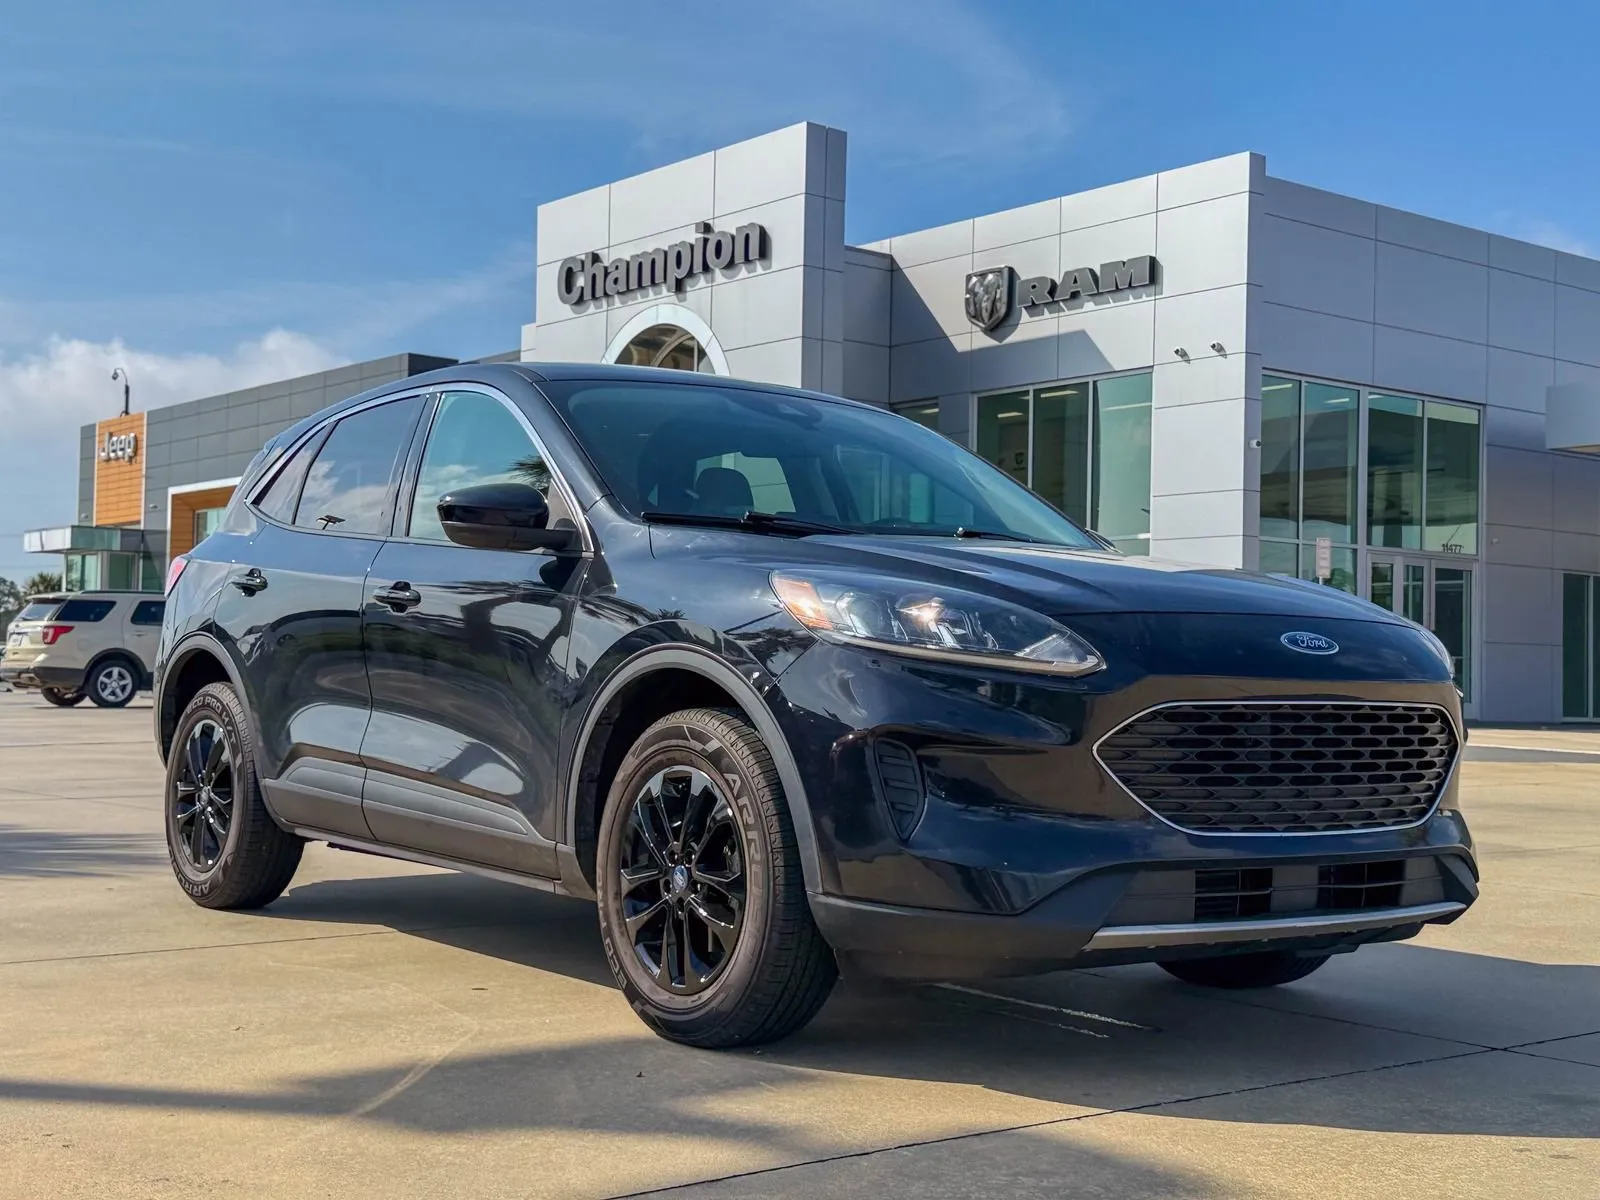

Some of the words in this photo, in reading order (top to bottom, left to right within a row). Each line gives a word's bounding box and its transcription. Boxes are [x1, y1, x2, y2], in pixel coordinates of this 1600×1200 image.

[557, 221, 766, 305] Champion
[1017, 255, 1156, 307] RAM
[99, 432, 136, 461] Jeep
[1296, 634, 1328, 648] Ford
[205, 696, 222, 713] PRO
